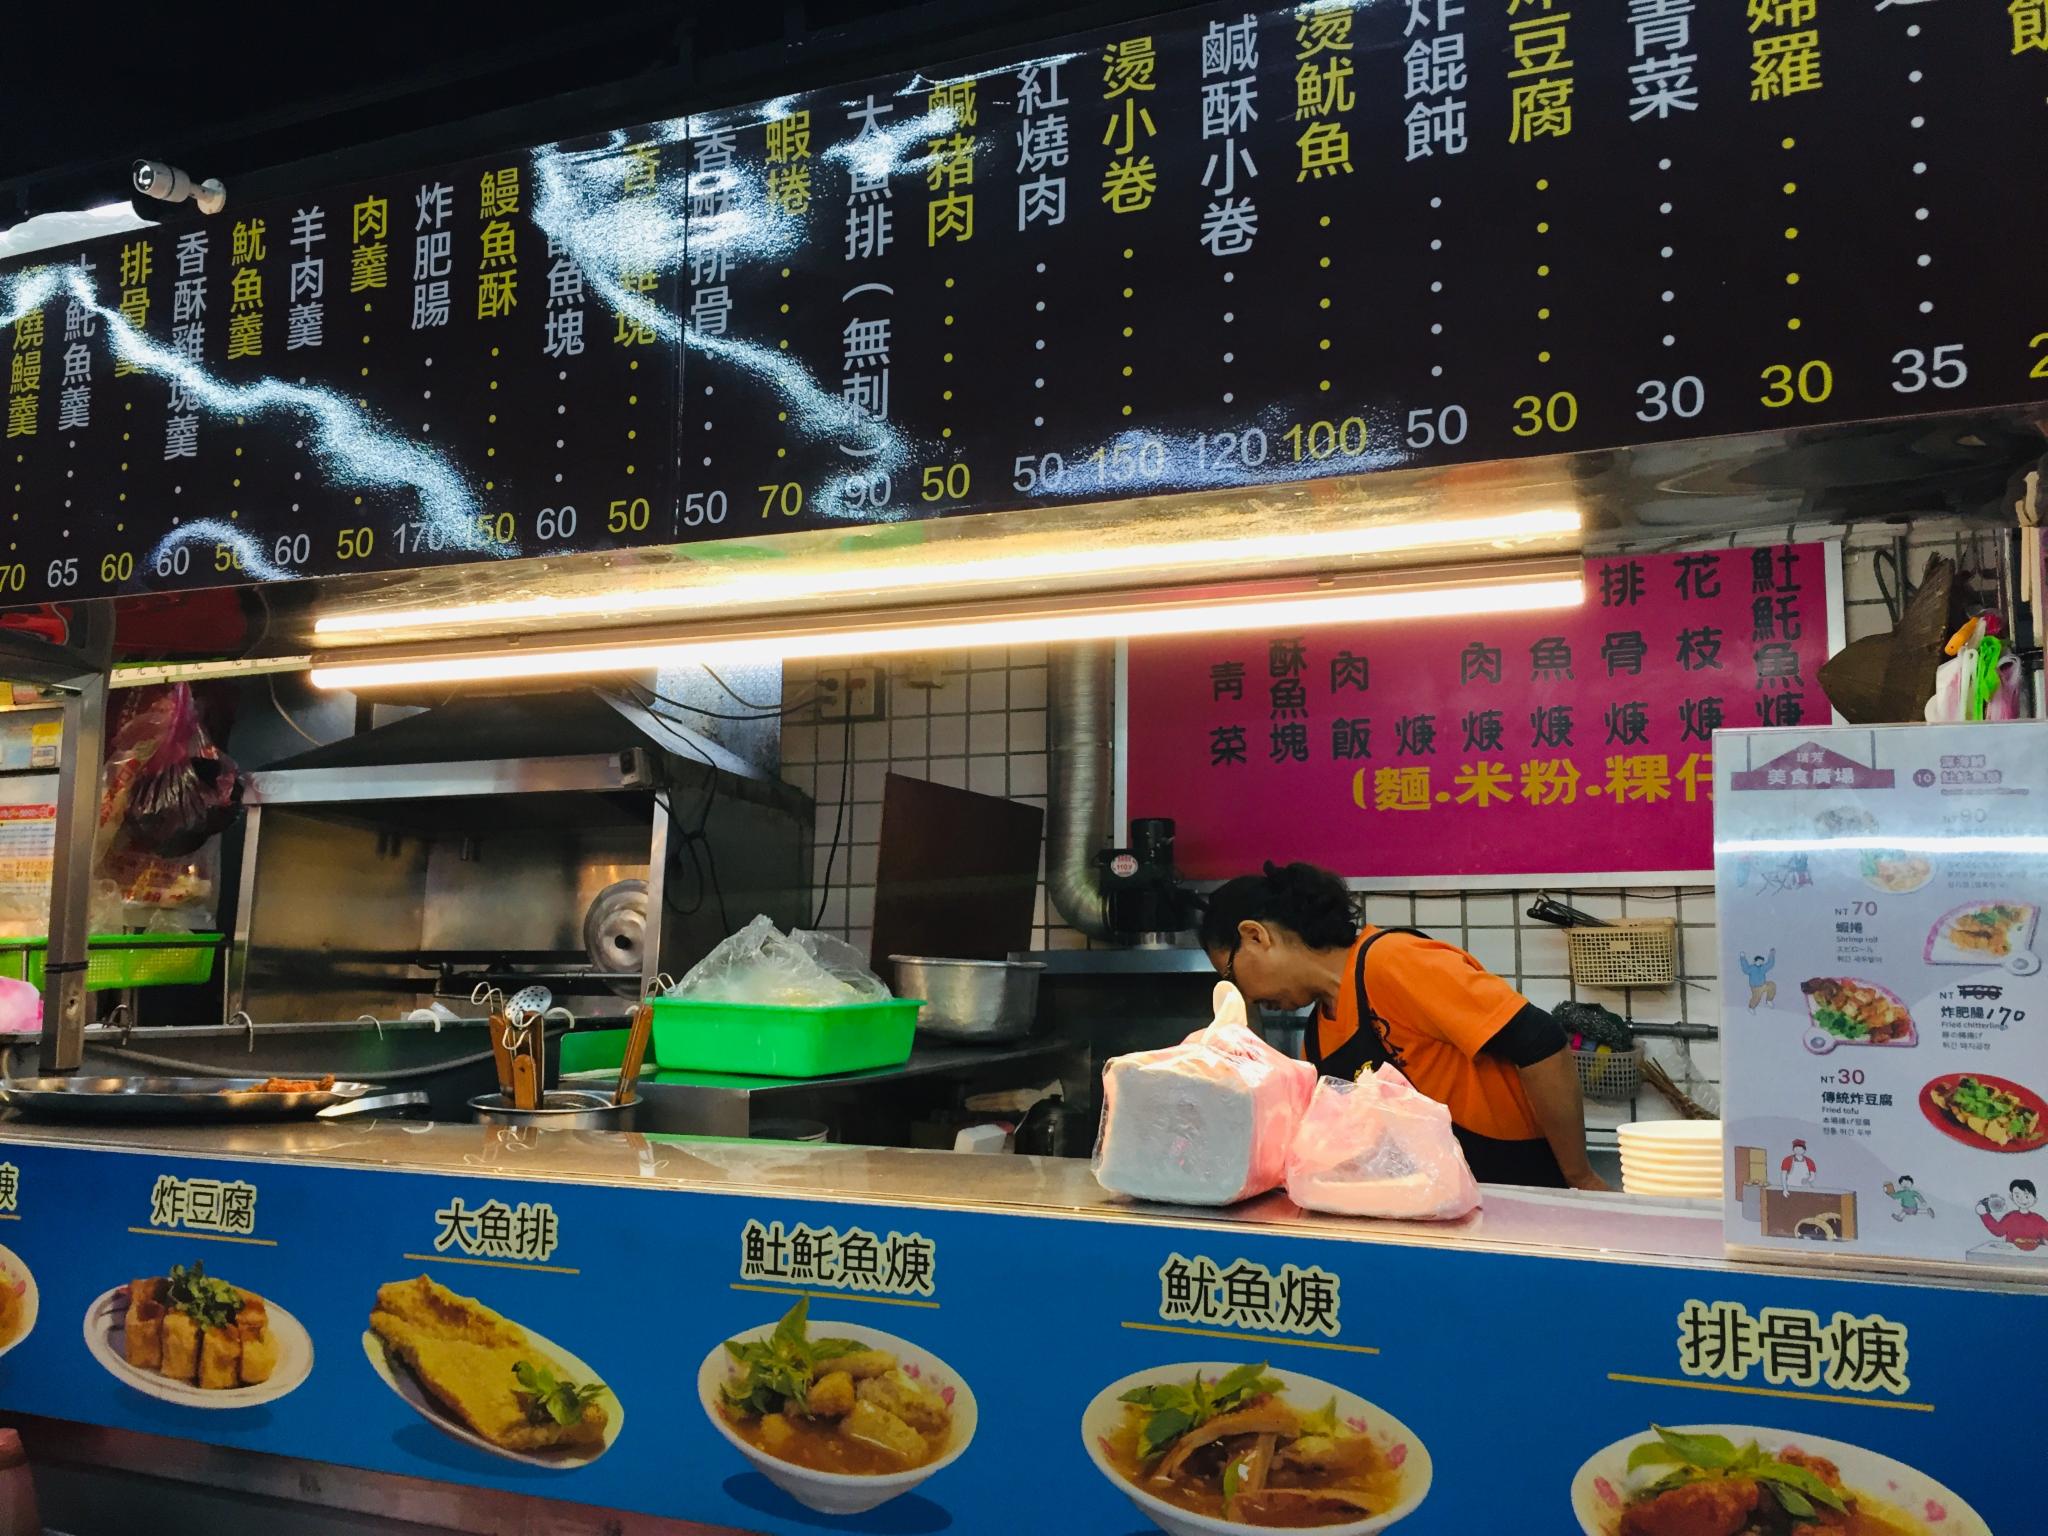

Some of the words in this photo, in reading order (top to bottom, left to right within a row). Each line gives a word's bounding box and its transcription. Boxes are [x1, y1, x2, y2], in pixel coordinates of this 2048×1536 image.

[1295, 1, 1355, 183] 燙魷魚
[1507, 0, 1574, 144] 豆腐
[1016, 61, 1069, 231] 紅燒肉
[1102, 37, 1157, 215] 燙小卷
[1200, 14, 1258, 256] 鹹酥小卷
[927, 80, 977, 247] 鹹豬肉
[350, 195, 388, 293] 肉羹
[411, 182, 454, 330] 炸肥腸
[478, 168, 520, 320] 鰻魚酥
[227, 218, 266, 360] 魷魚羹
[287, 206, 326, 351] 羊肉羹
[114, 241, 153, 378] 排骨
[1760, 360, 1833, 408] 30
[1891, 344, 1969, 394] 35
[1512, 391, 1578, 437] 30
[1635, 375, 1705, 422] 30
[1283, 416, 1367, 462] 100
[1406, 405, 1468, 449] 50
[1092, 442, 1166, 481] 150
[1197, 427, 1268, 469] 120
[845, 475, 891, 508] 90
[921, 463, 971, 501] 50
[1013, 452, 1064, 492] 50
[607, 498, 650, 533] 50
[684, 490, 728, 526] 50
[758, 482, 803, 518] 70
[336, 527, 374, 559] 50
[393, 522, 444, 553] 170
[536, 506, 577, 540] 60
[101, 552, 134, 582] 60
[156, 546, 190, 576] 60
[274, 534, 311, 564] 60
[0, 564, 26, 592] 70
[47, 558, 79, 588] 65
[1209, 661, 1247, 767] 青菜
[1767, 768, 1855, 785] 美食廣場
[1851, 901, 1878, 916] 70
[1941, 1006, 1984, 1019] 炸肥腸
[1987, 1006, 2026, 1026] 170
[1821, 1076, 1835, 1084] NT
[1838, 1069, 1865, 1085] 30
[1822, 1091, 1893, 1106] 傳統炸豆腐
[1822, 1106, 1841, 1114] Fried
[1843, 1107, 1860, 1115] tofu
[153, 1179, 254, 1230] 炸豆腐
[434, 1201, 557, 1258] 大魚排
